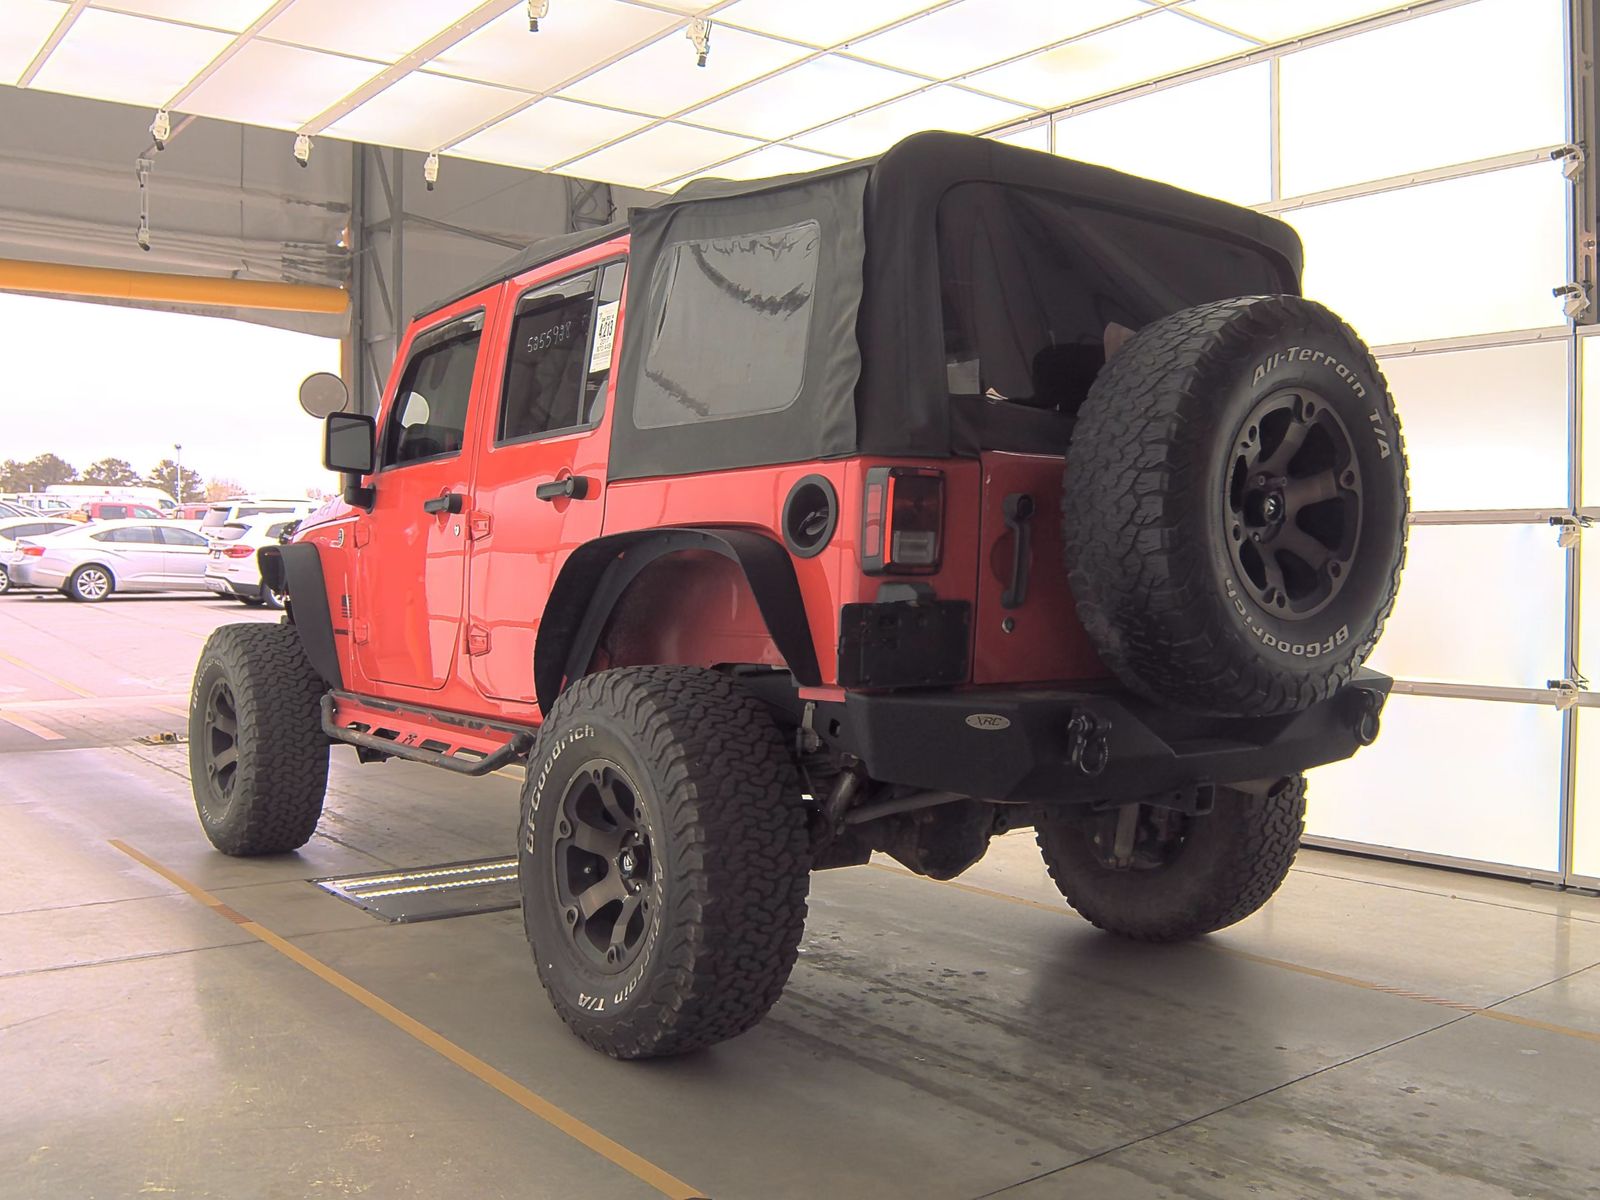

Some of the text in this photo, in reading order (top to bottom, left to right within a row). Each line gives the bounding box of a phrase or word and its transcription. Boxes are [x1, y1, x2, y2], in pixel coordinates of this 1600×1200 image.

[1252, 346, 1391, 459] All-Terrain T/A
[1225, 578, 1349, 658] BFGoodrich
[526, 724, 595, 855] BFGoodrich
[577, 992, 605, 1011] T/A
